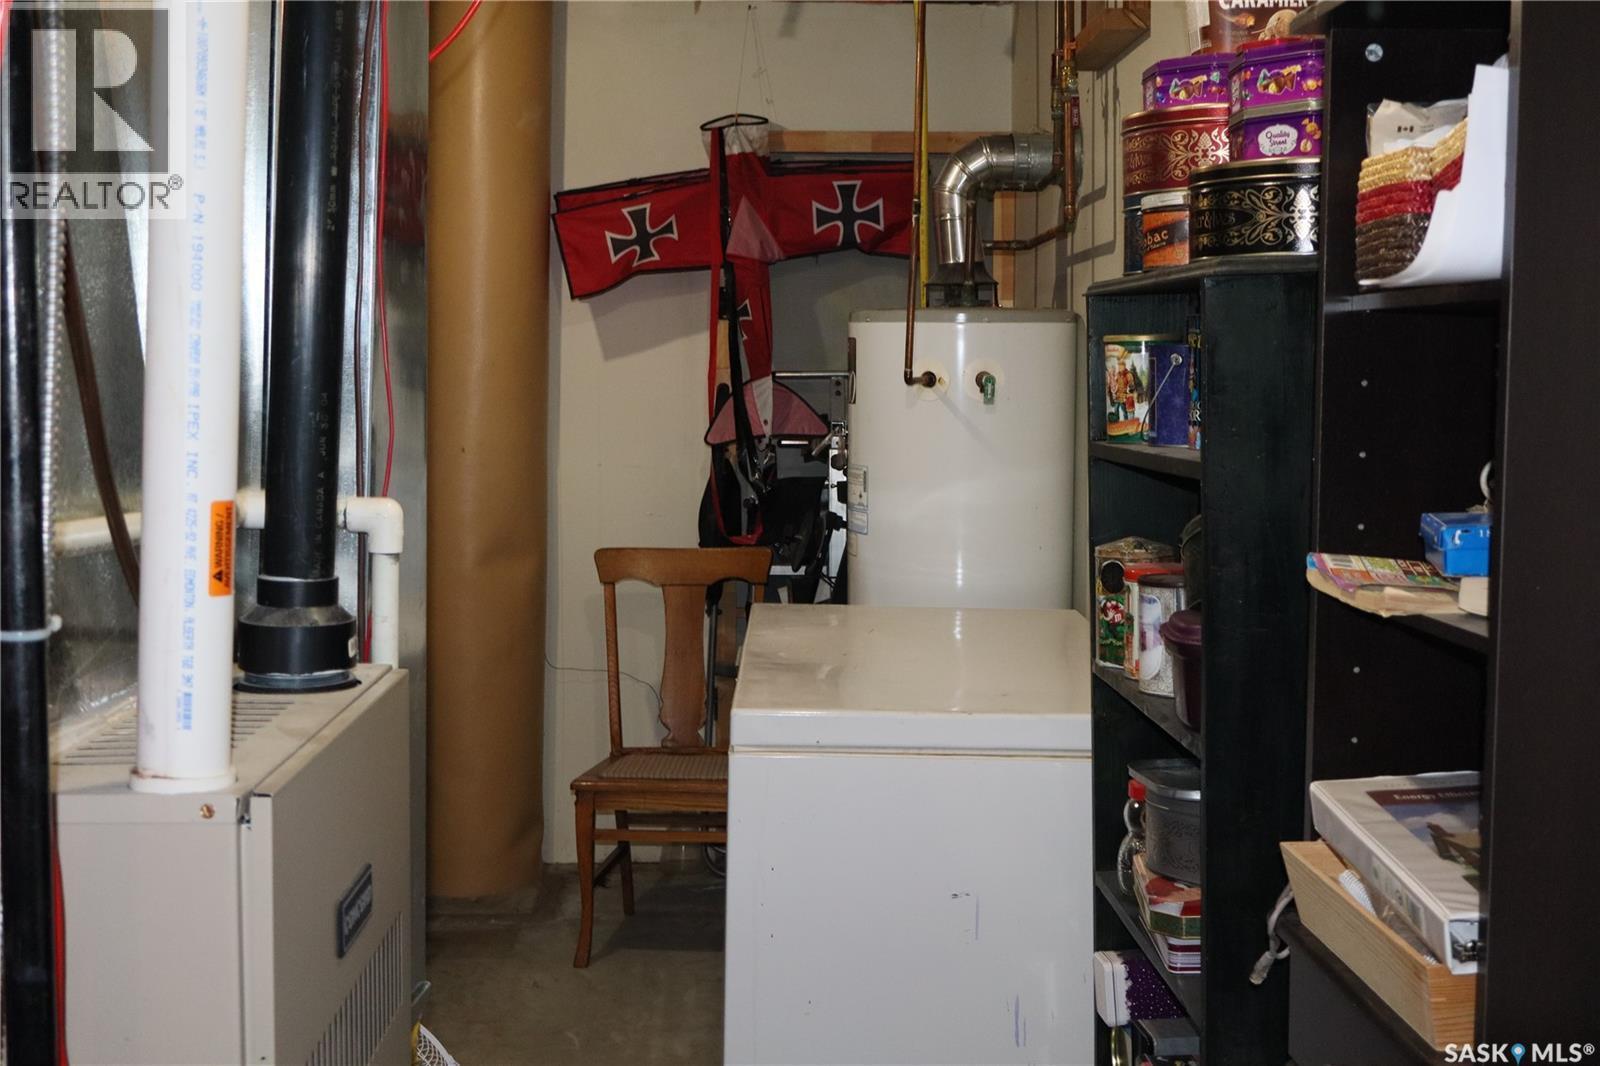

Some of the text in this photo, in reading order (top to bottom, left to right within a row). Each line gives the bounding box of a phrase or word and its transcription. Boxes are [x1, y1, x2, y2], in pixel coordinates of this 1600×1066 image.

[1265, 130, 1290, 139] Quality
[186, 404, 200, 440] IPEX
[215, 520, 225, 567] WARNING
